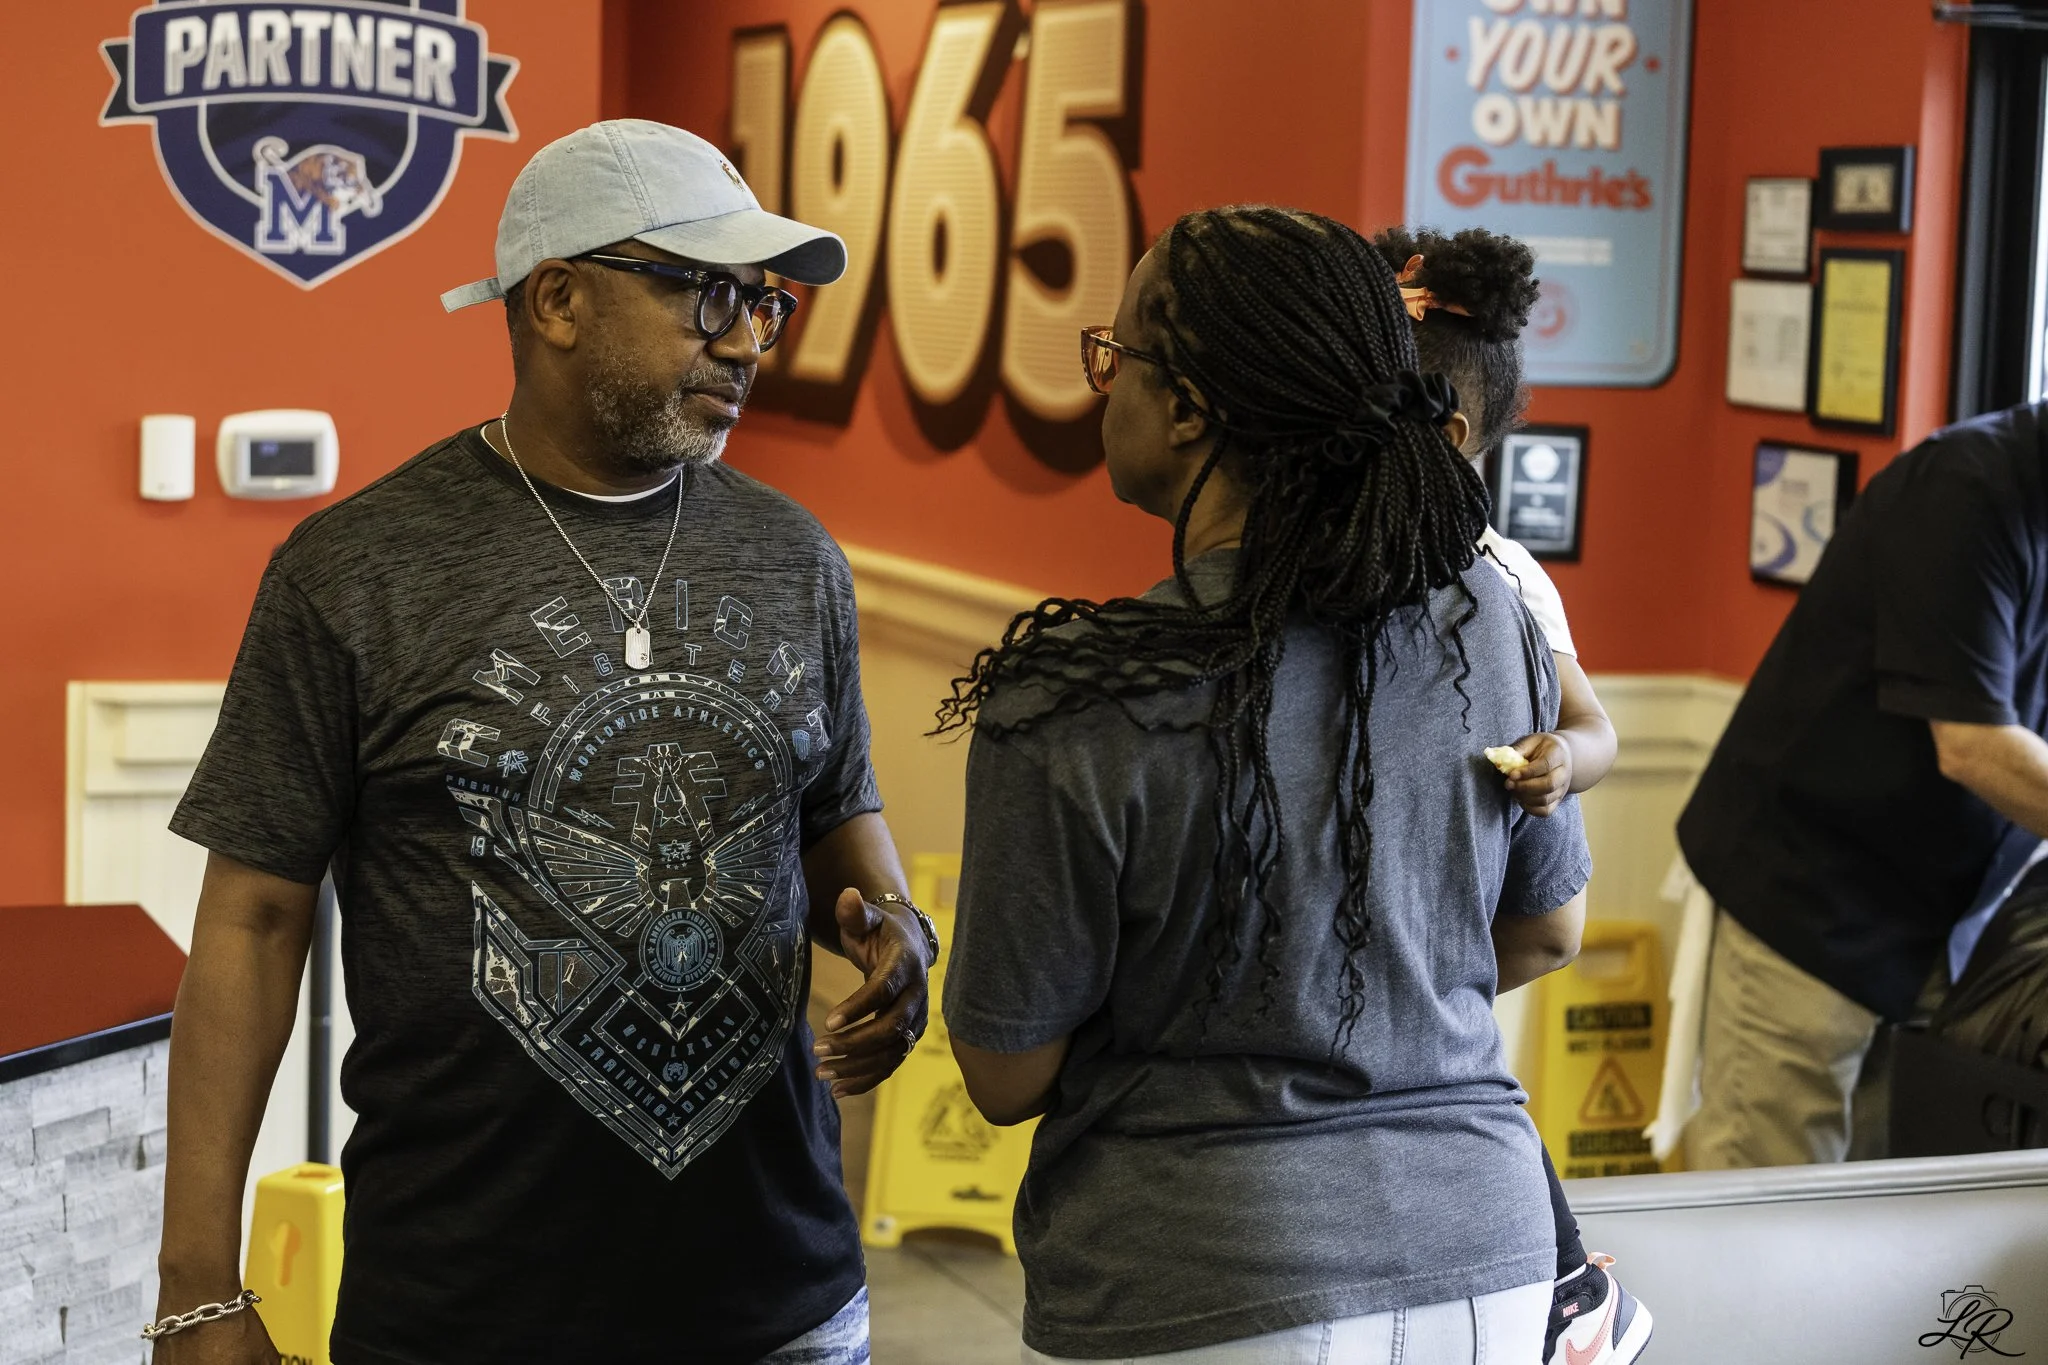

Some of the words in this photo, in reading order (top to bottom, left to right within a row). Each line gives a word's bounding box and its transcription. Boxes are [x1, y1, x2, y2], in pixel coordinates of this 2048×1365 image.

[164, 9, 457, 108] PARTNER
[1466, 15, 1637, 96] YOUR
[1471, 92, 1621, 151] OWN
[732, 2, 1132, 423] 1965
[1436, 145, 1655, 210] Guthrie's
[530, 642, 782, 727] FIGTER
[568, 705, 660, 783] WORLDWIDE
[673, 705, 766, 770] ATHLETICS
[445, 773, 521, 803] PREMIUM
[470, 835, 487, 857] 19
[649, 911, 684, 944] AMERICAN
[686, 911, 716, 940] FIGHTER
[579, 1033, 667, 1117] TRAINING
[1562, 1301, 1580, 1318] NIKE
